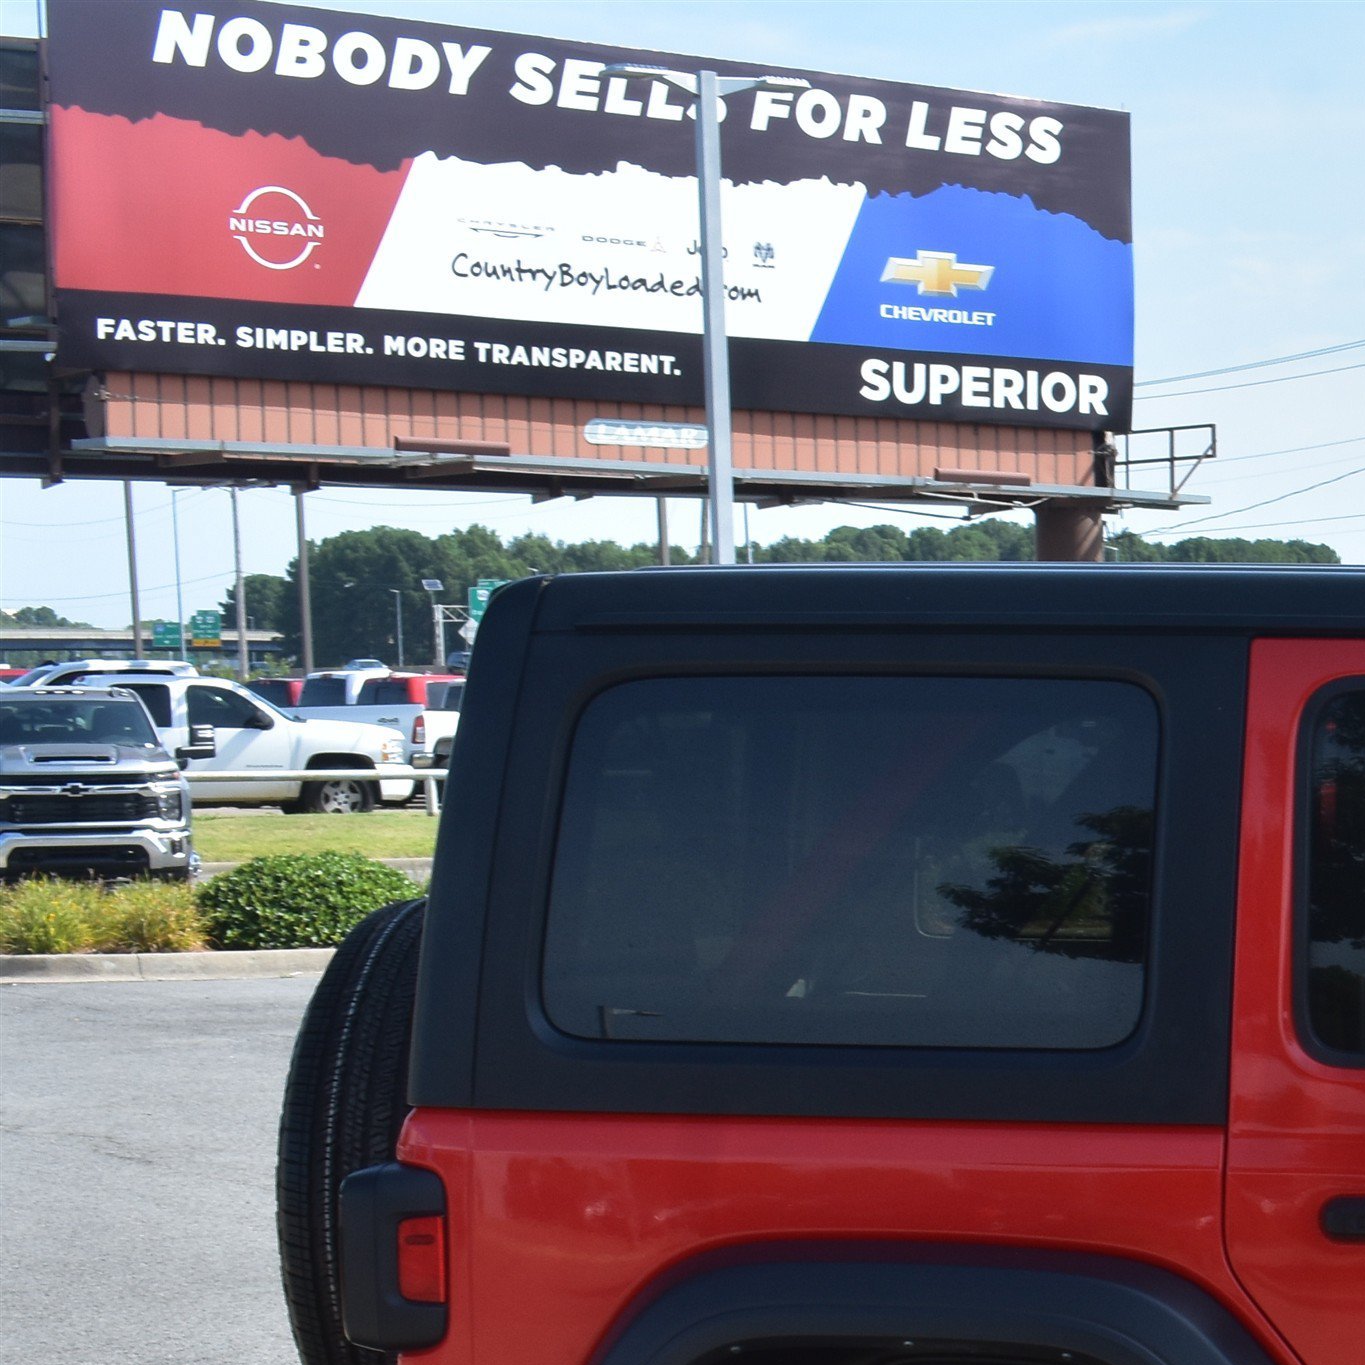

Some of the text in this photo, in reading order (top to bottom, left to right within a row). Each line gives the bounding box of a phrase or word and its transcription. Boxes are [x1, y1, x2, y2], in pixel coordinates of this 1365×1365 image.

[152, 9, 493, 95] NOBODY
[750, 89, 887, 145] FOR
[905, 100, 1064, 164] LESS
[229, 217, 325, 238] NISSAN
[582, 235, 647, 246] DODGE
[451, 253, 761, 303] CountryBoyLoadedom
[879, 303, 997, 326] CHEVROLET
[96, 318, 682, 376] FASTER. SIMPLER. MORE TRANSPARENT.
[859, 358, 1109, 416] SUPERIOR
